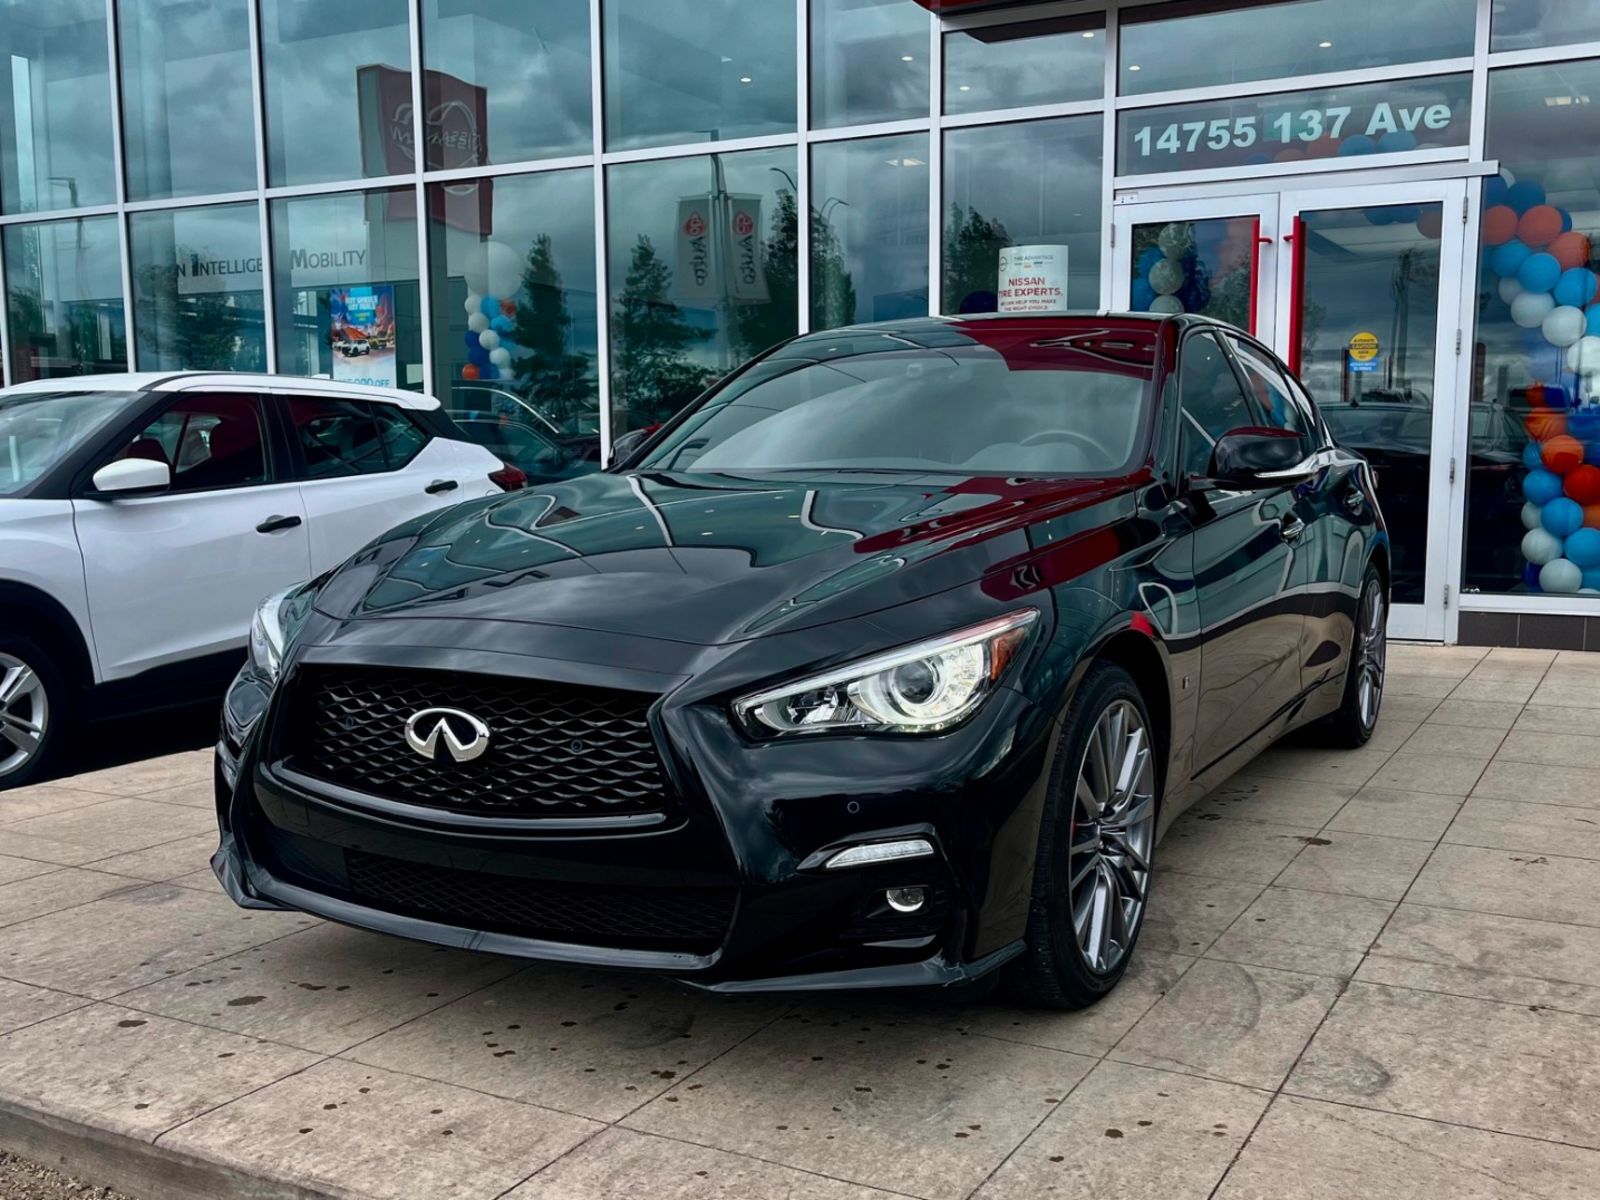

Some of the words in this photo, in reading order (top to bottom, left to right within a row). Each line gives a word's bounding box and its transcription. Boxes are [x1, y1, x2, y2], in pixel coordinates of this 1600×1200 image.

[1134, 117, 1257, 157] 14755
[1272, 106, 1352, 144] 137
[1365, 102, 1452, 136] Ave
[290, 248, 366, 270] MOBILITY
[1008, 276, 1045, 287] NISSAN
